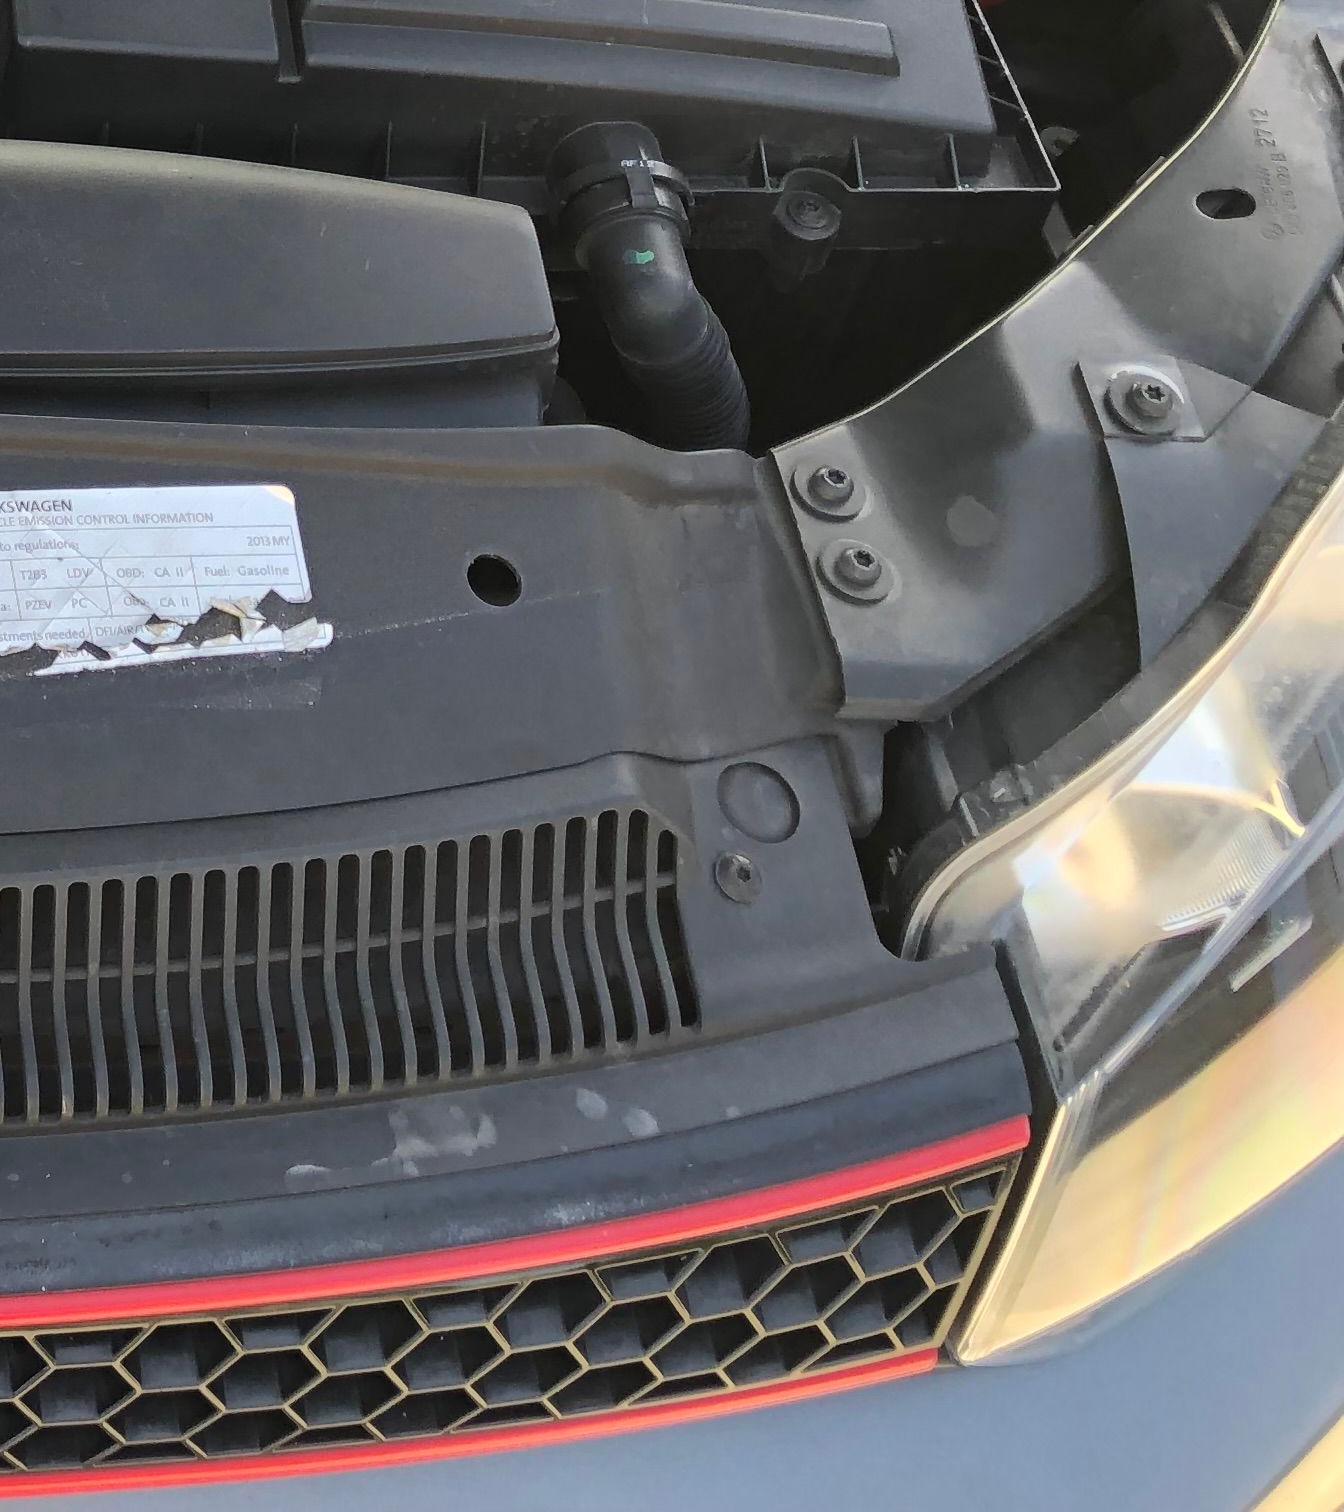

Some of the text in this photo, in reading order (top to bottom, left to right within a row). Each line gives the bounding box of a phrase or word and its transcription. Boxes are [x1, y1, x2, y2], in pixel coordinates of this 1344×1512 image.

[18, 515, 73, 527] EMISSION
[76, 512, 130, 525] CONTROL
[133, 512, 213, 525] INFORMATION
[0, 542, 12, 552] to
[247, 535, 290, 547] 2013 MY
[20, 569, 48, 580] T2B5
[67, 567, 91, 579] LDV
[116, 567, 145, 579] OBD:
[154, 566, 171, 577] CA
[204, 566, 230, 577] Fuel:
[238, 565, 289, 576] Gasoline
[25, 599, 52, 610] PZEV
[71, 598, 88, 609] PC
[160, 597, 176, 607] CA
[44, 629, 88, 640] needed.
